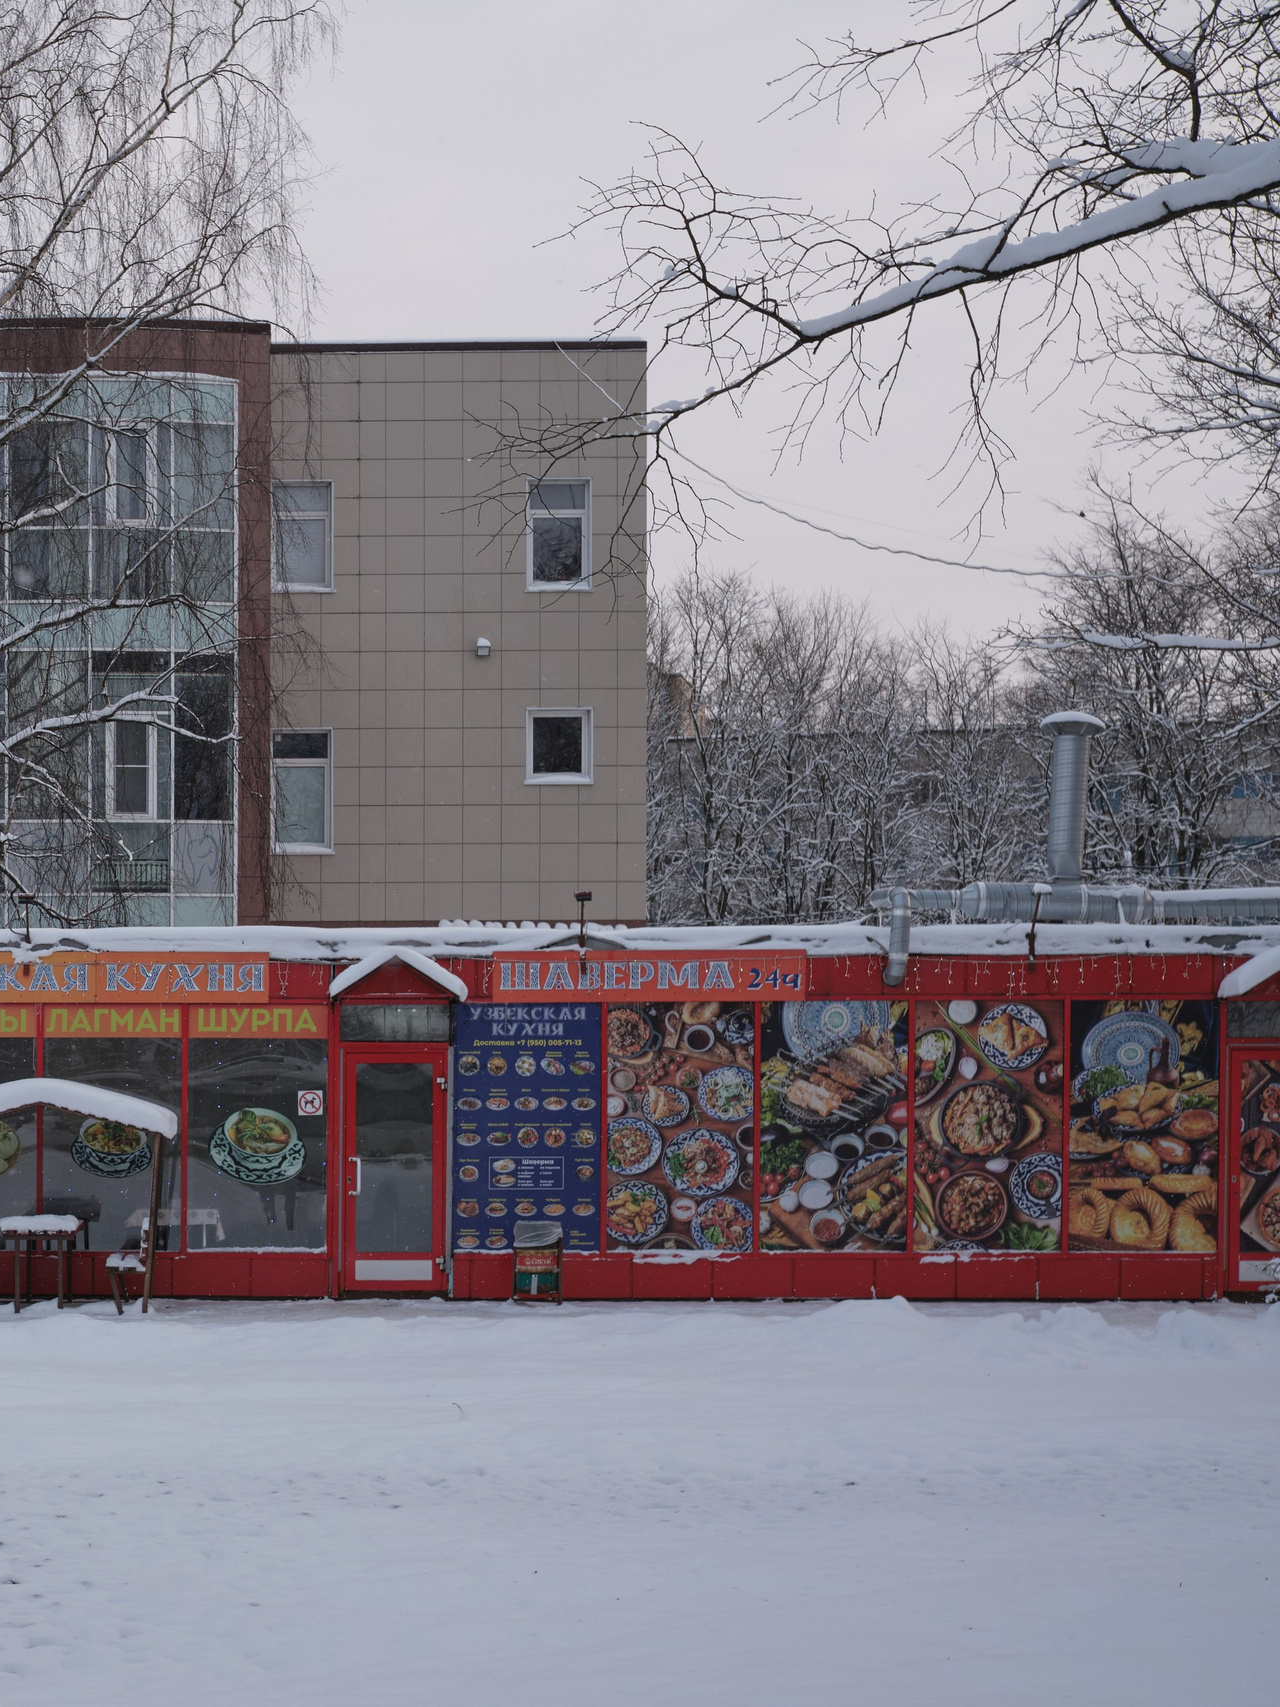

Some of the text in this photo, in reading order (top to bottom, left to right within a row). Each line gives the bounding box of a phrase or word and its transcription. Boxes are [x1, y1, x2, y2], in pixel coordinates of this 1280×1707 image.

[104, 962, 267, 993] КУХНЯ
[498, 960, 802, 991] ШАВЕРМА 24ч
[46, 1009, 180, 1032] ЛАГМАН
[197, 1008, 318, 1033] ШУРПА
[469, 1006, 587, 1021] УЗБЕКСКАЯ
[491, 1022, 565, 1036] КУХНЯ
[473, 1039, 515, 1047] Доставка
[521, 1158, 555, 1166] Шаверма
